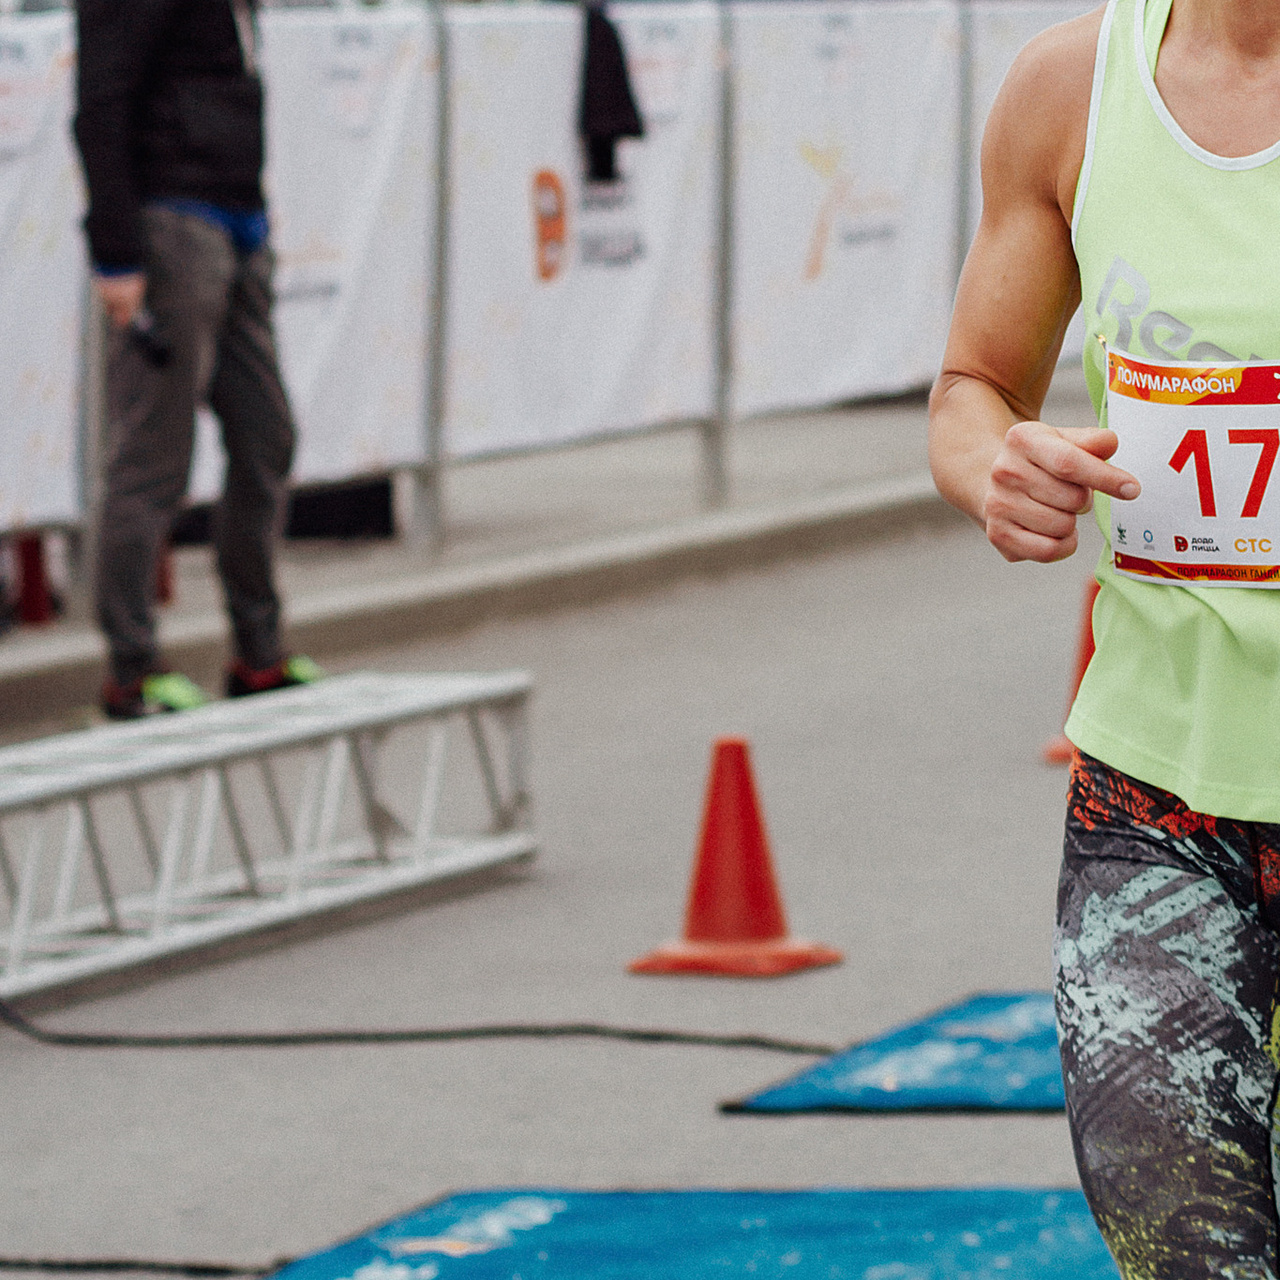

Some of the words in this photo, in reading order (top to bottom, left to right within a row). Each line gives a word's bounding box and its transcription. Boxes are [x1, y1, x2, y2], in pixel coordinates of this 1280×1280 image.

[1117, 365, 1236, 395] ПОЛУМАРАФОН
[1167, 428, 1280, 519] 17
[1191, 545, 1220, 553] ПИЦЦА
[1234, 538, 1273, 553] СТС
[1177, 567, 1247, 579] ПОЛУМАРАФОН
